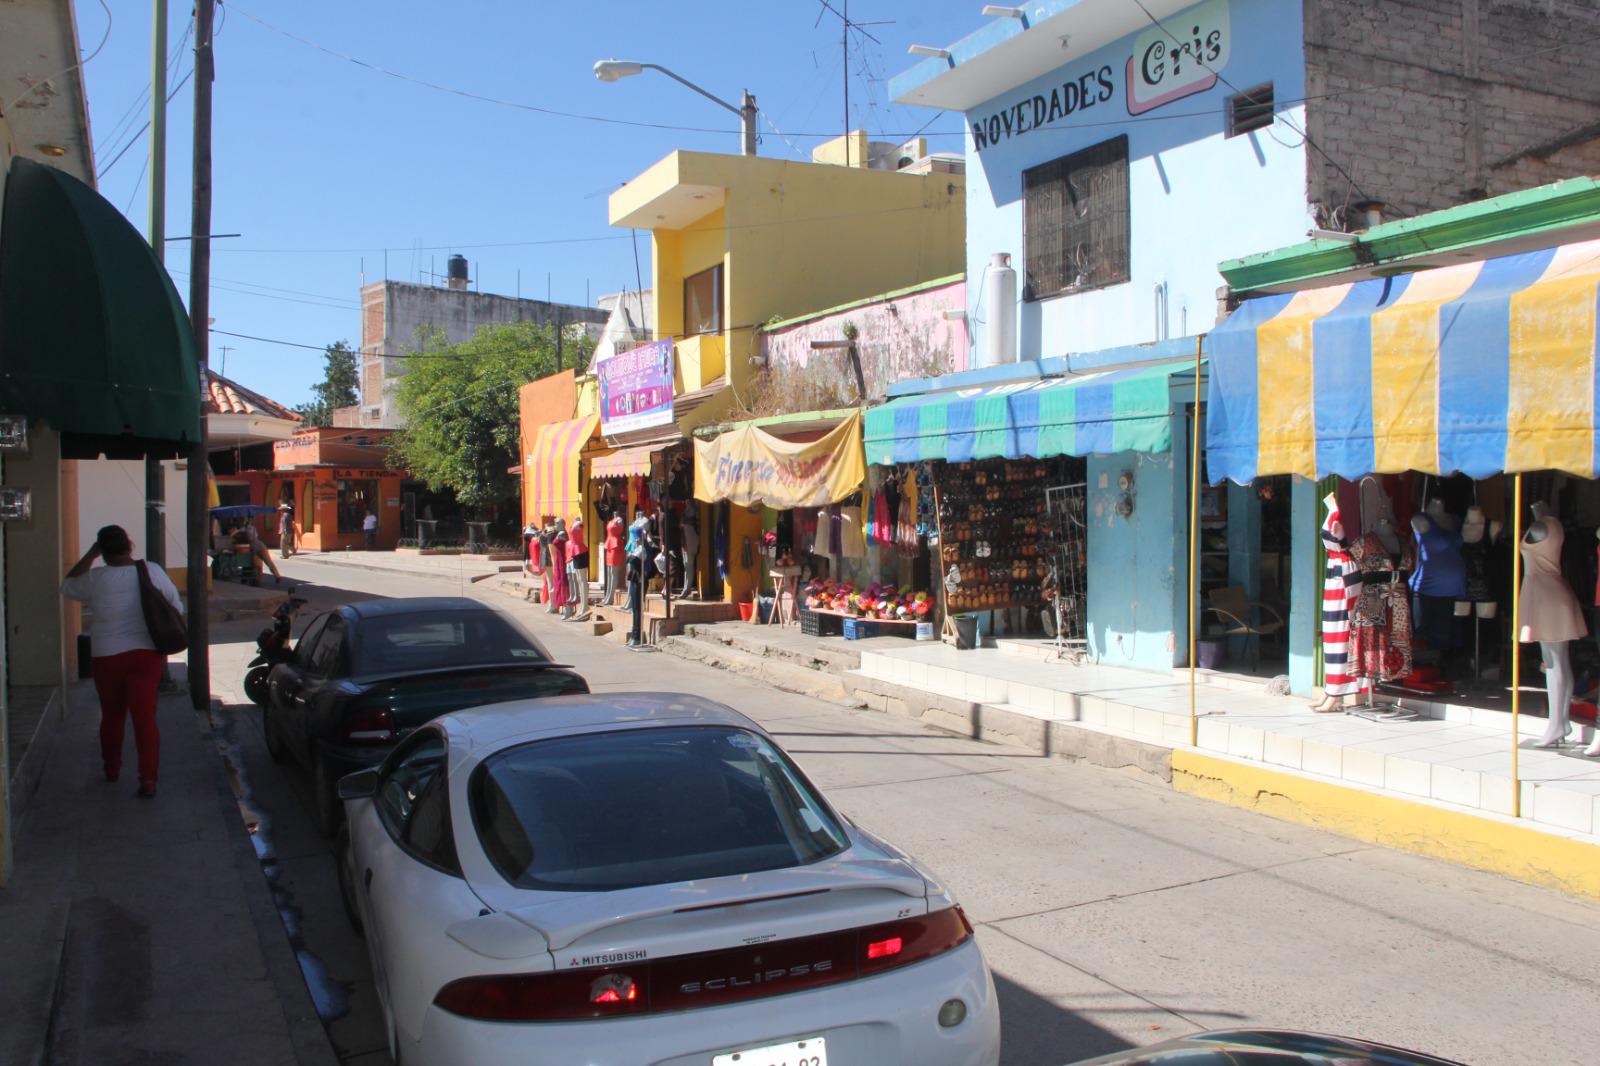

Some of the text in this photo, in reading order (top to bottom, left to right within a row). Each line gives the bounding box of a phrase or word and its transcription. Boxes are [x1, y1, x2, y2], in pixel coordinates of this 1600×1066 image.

[973, 25, 1221, 152] NOVEDADES Gris
[582, 950, 647, 965] MITSUBISHI
[680, 960, 833, 993] ECLIPSE
